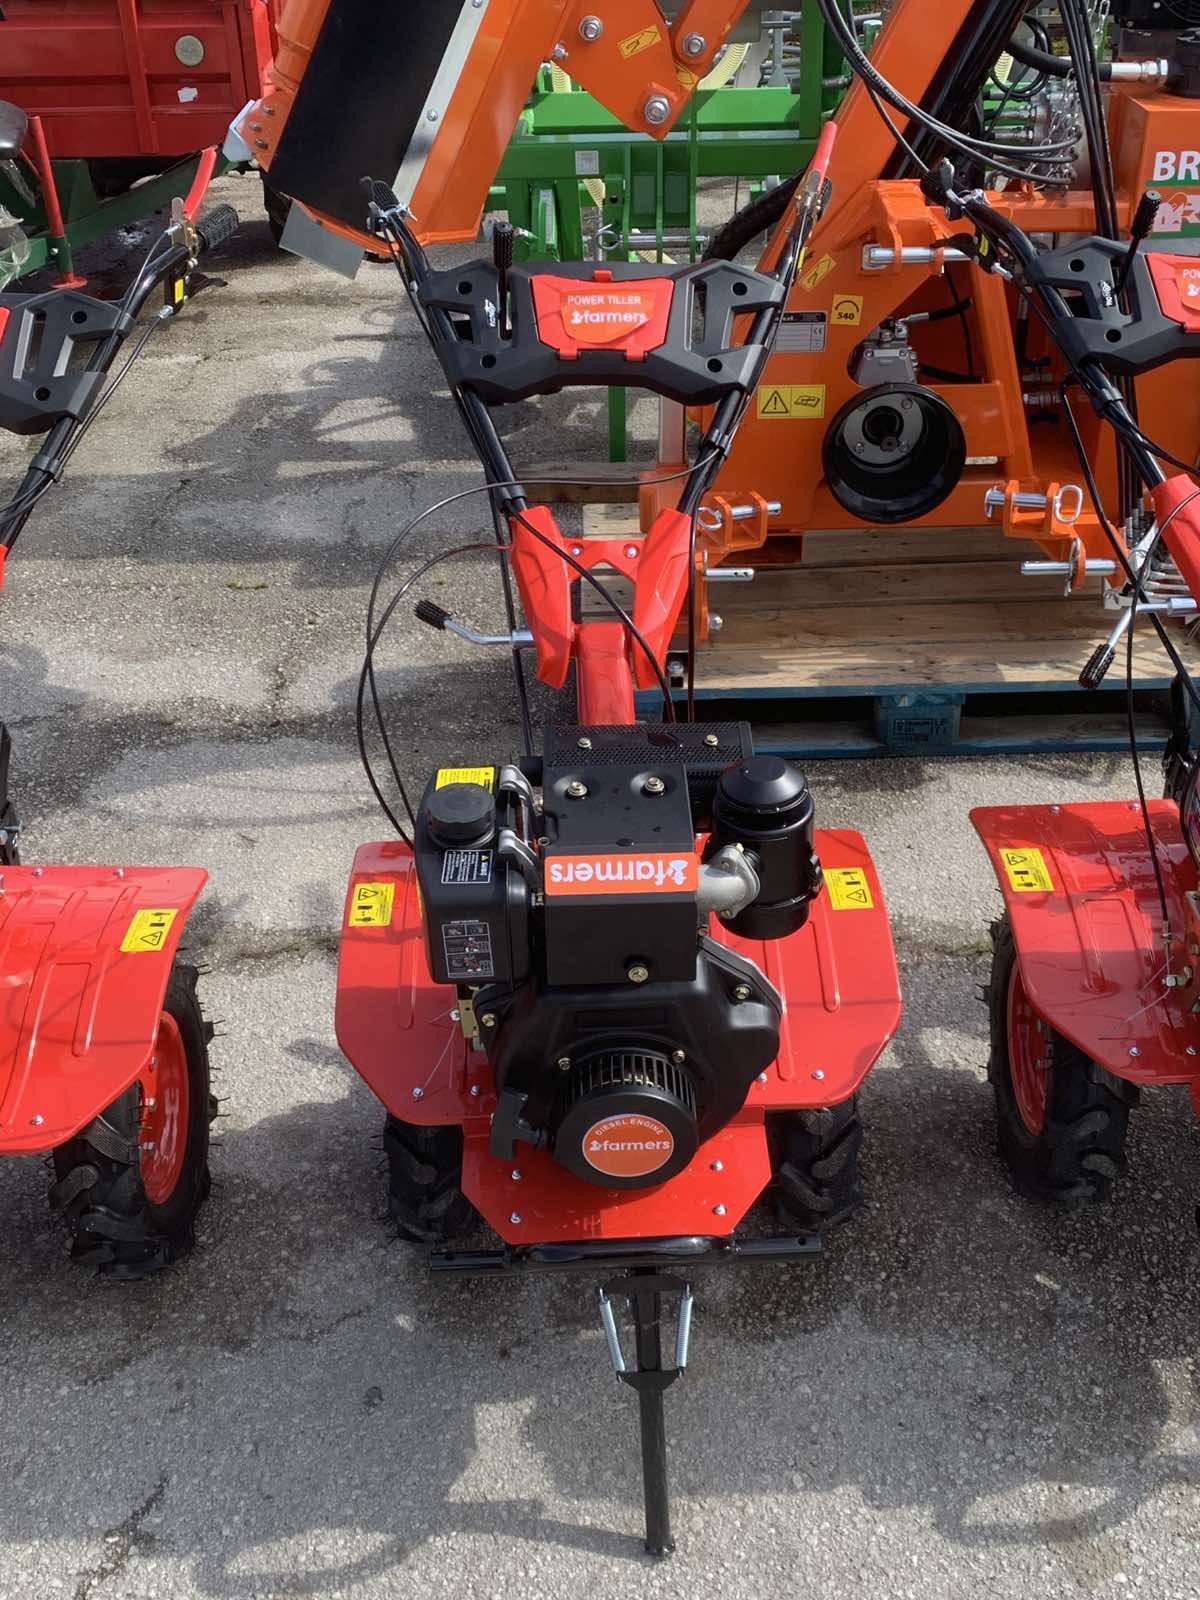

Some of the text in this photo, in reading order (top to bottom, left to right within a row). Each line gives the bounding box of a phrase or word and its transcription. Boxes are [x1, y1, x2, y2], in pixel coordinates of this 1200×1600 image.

[567, 295, 641, 305] POWER TILLER
[584, 310, 649, 326] farmers
[837, 311, 855, 320] 540
[550, 860, 666, 886] farmers
[595, 1118, 664, 1136] DIESEL ENGINE
[603, 1140, 670, 1151] farmers
